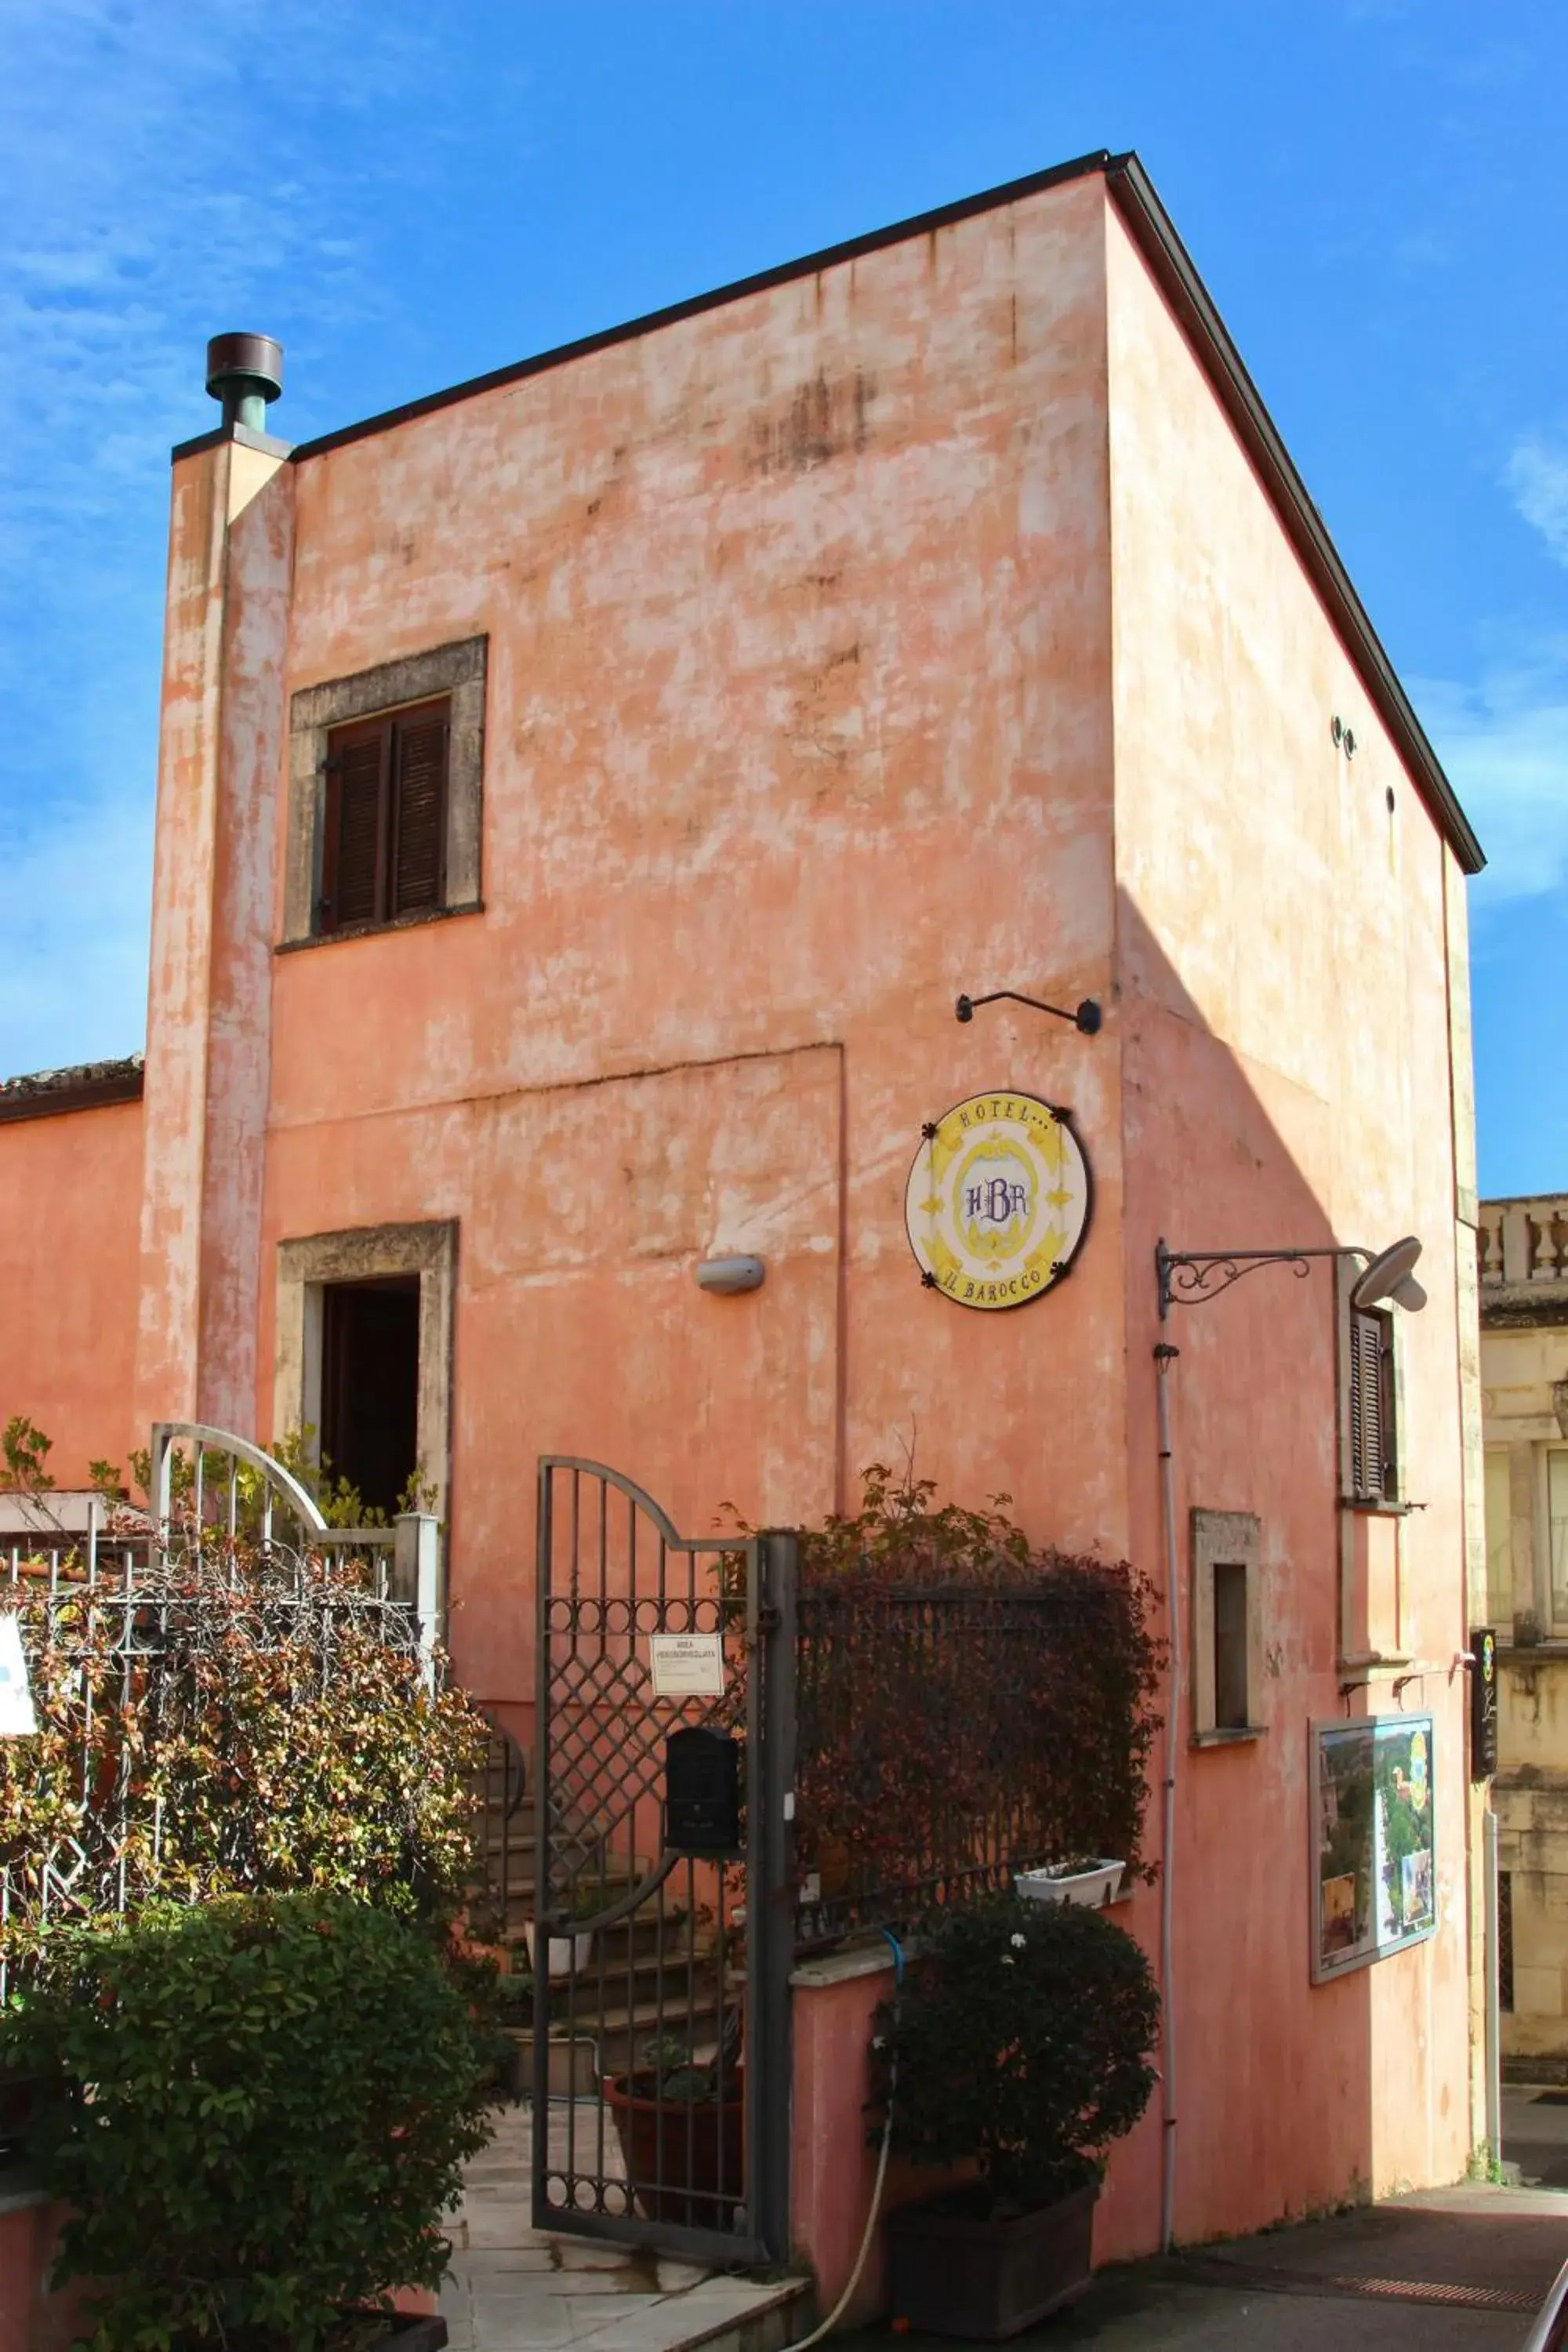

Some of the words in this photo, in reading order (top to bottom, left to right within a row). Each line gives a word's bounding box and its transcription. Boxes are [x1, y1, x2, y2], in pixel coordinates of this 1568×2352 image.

[959, 1100, 1029, 1128] HOTEL
[966, 1178, 1029, 1223] HBR
[941, 1271, 958, 1293] IL
[964, 1269, 1041, 1302] BAROCCO
